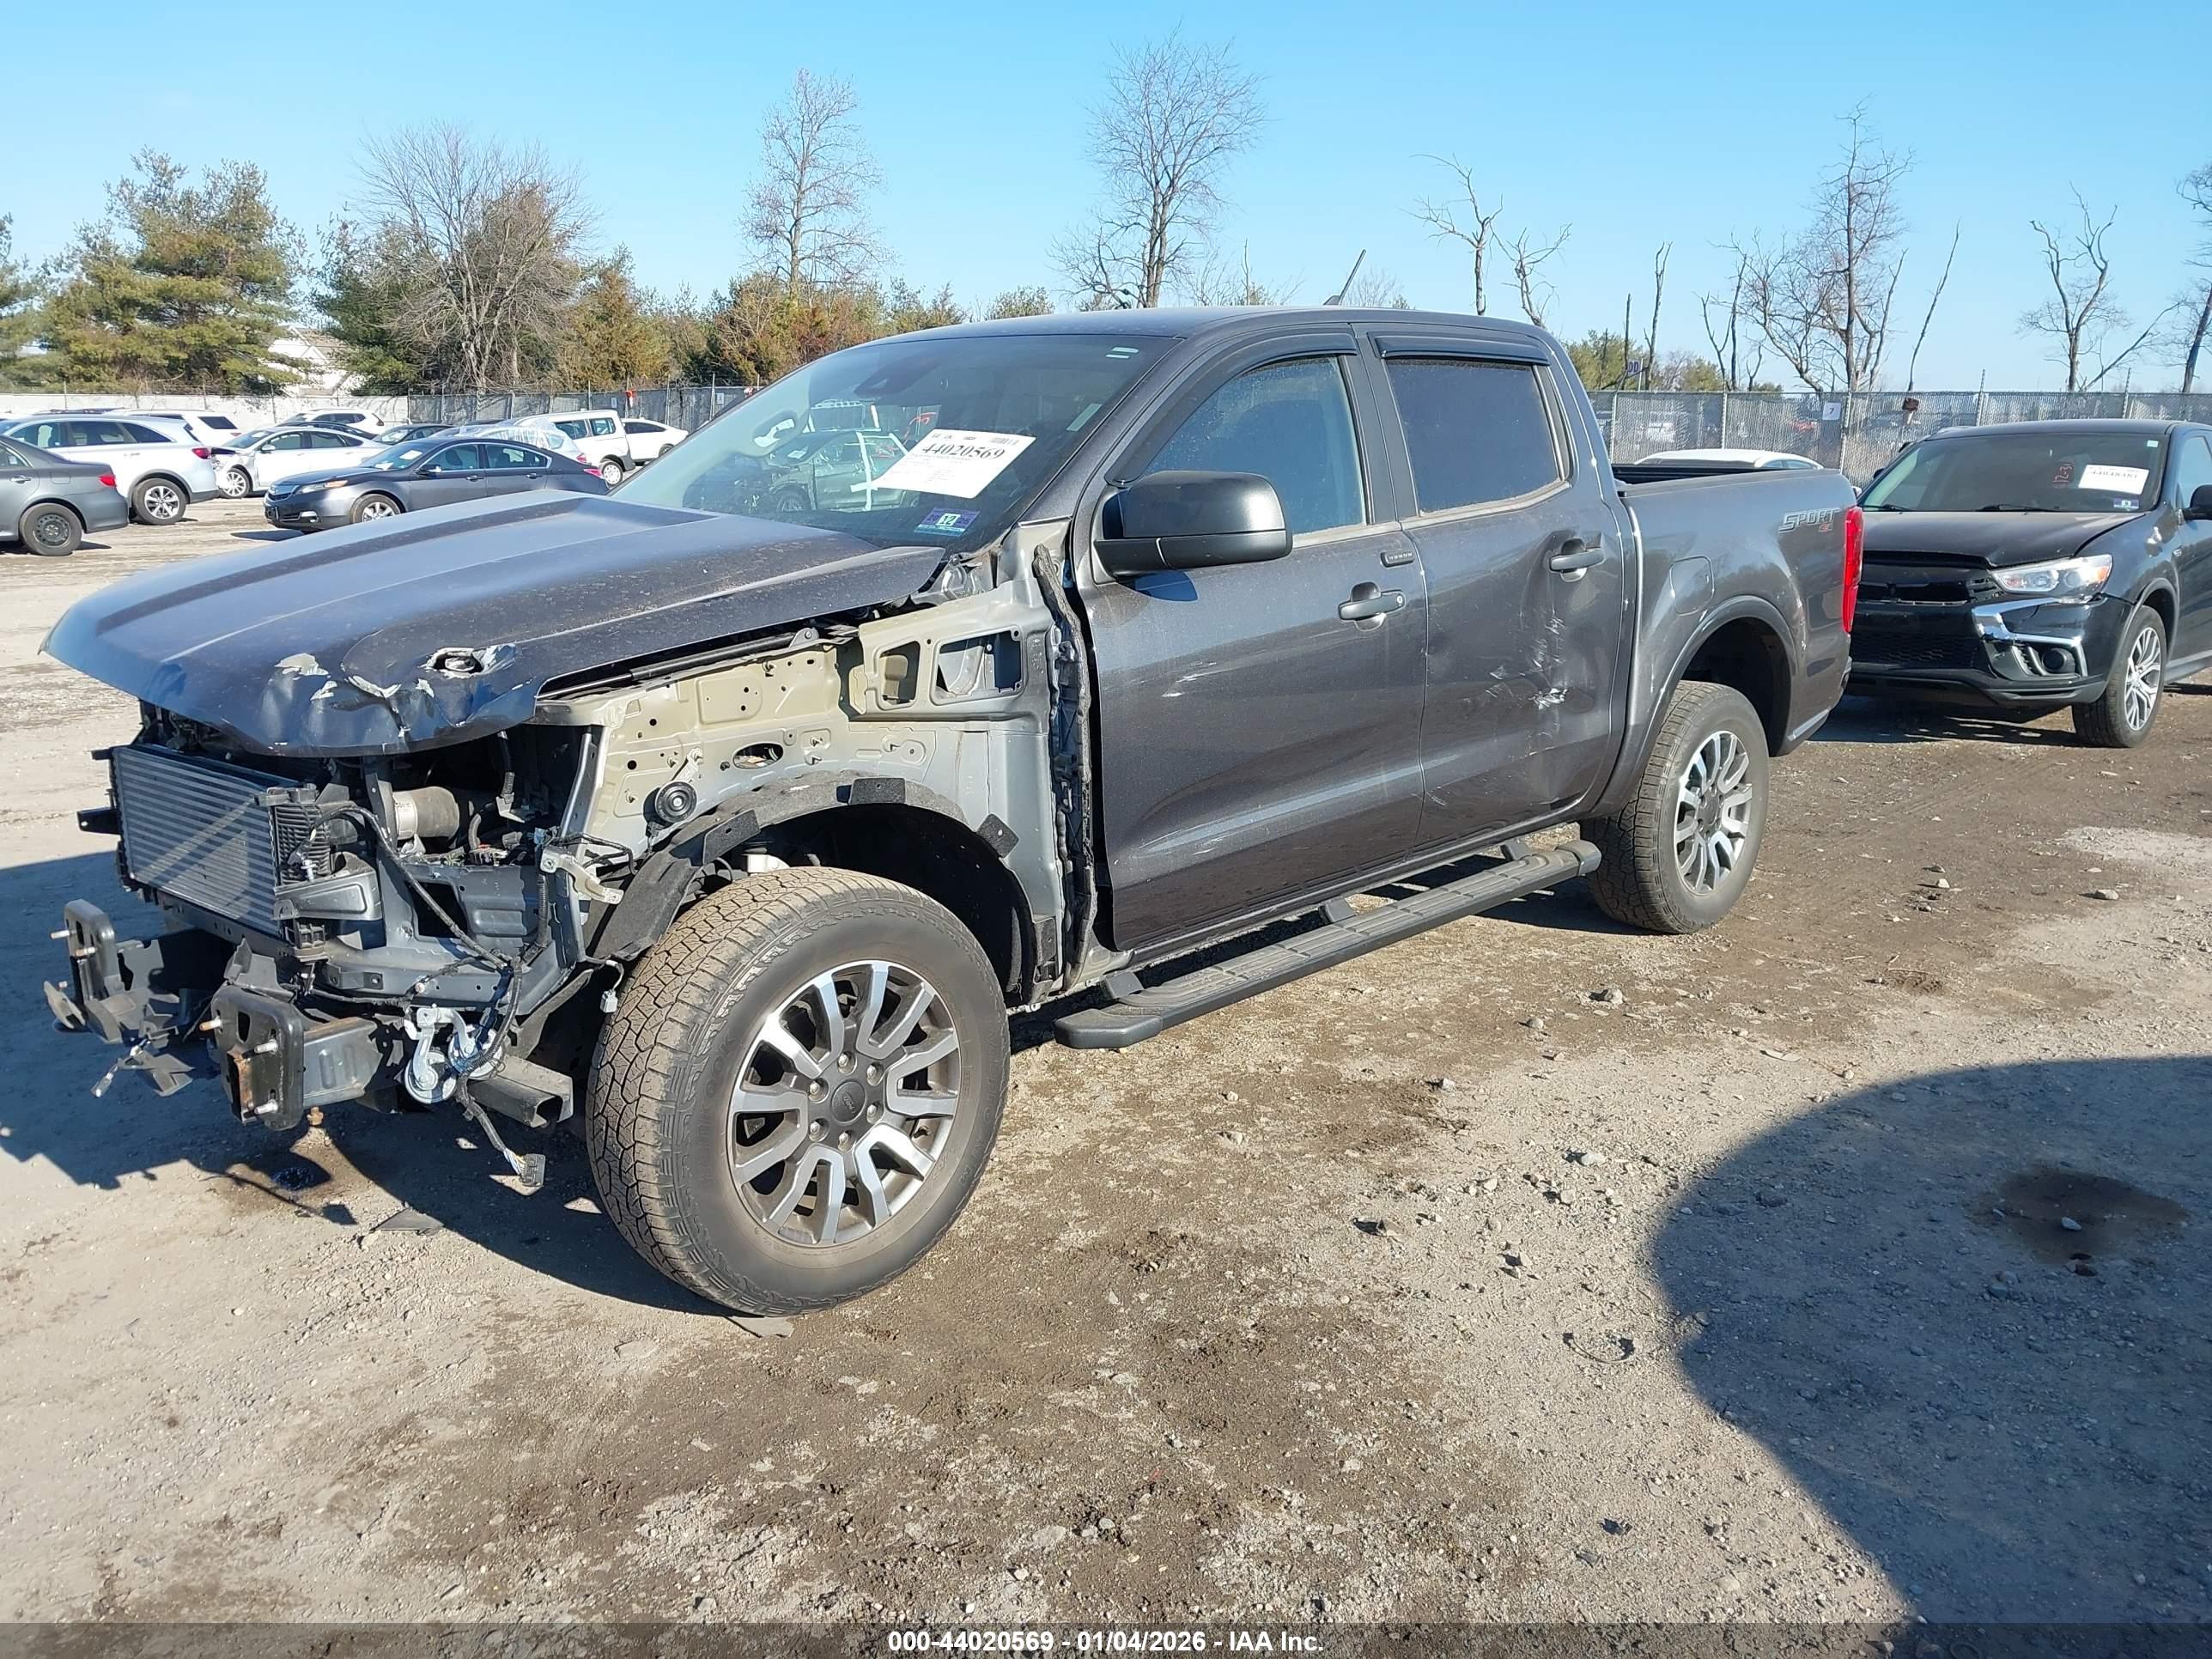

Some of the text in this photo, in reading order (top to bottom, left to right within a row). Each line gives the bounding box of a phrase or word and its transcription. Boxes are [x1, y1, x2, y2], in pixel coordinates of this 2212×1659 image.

[921, 442, 1006, 459] 44020569
[939, 514, 957, 526] 12
[1778, 508, 1840, 533] SPORT
